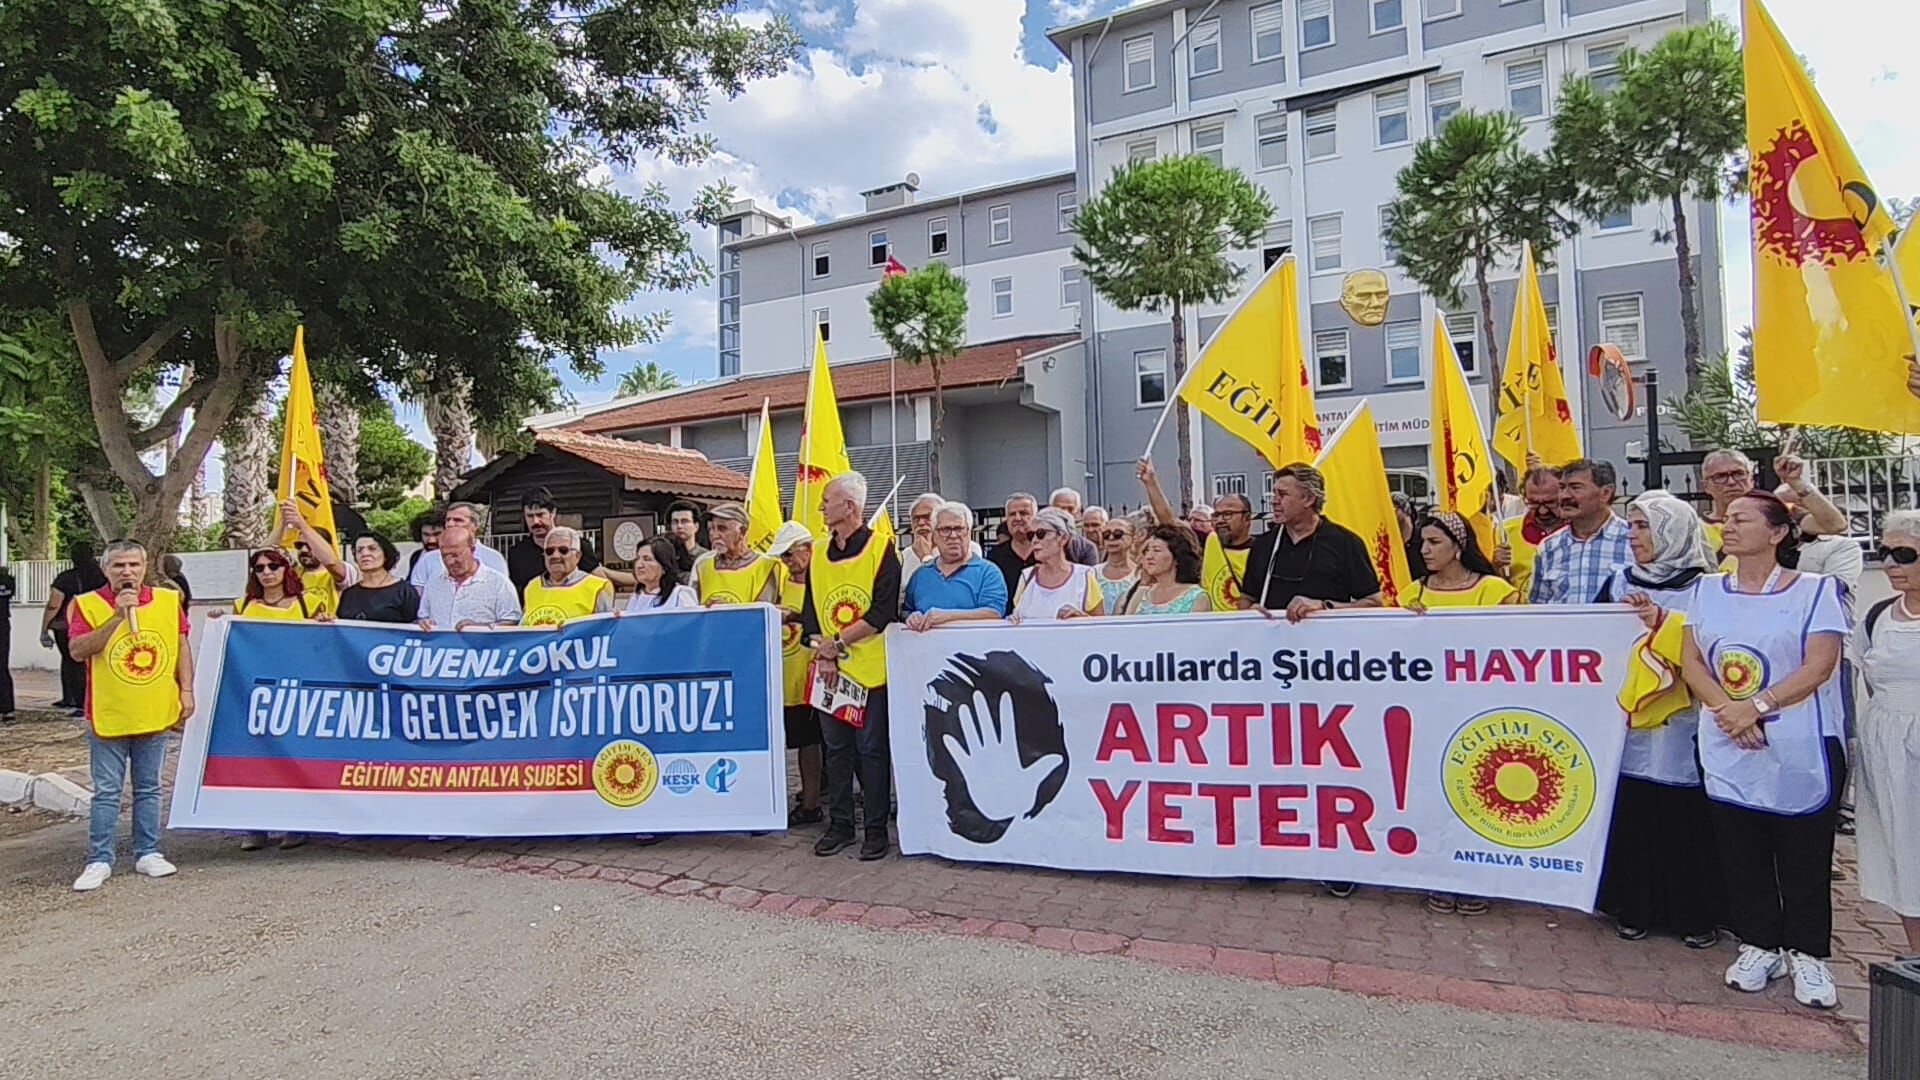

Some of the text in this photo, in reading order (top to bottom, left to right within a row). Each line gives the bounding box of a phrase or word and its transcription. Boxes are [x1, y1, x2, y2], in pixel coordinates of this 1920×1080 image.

[520, 635, 617, 675] OKUL
[1083, 649, 1603, 688] Okullarda Şiddete HAYIR
[247, 679, 391, 739] GÜVENLİ
[550, 675, 734, 737] İSTİYORUZ!
[1095, 703, 1362, 768] ARTIK
[1451, 718, 1584, 769] EĞİTİM SEN
[340, 761, 404, 787] EĞİTİM
[407, 765, 443, 788] SEN
[445, 763, 519, 788] ANTALYA
[523, 760, 585, 790] ŞUBESİ
[662, 774, 700, 786] KESK
[1453, 850, 1524, 867] ANTALYA
